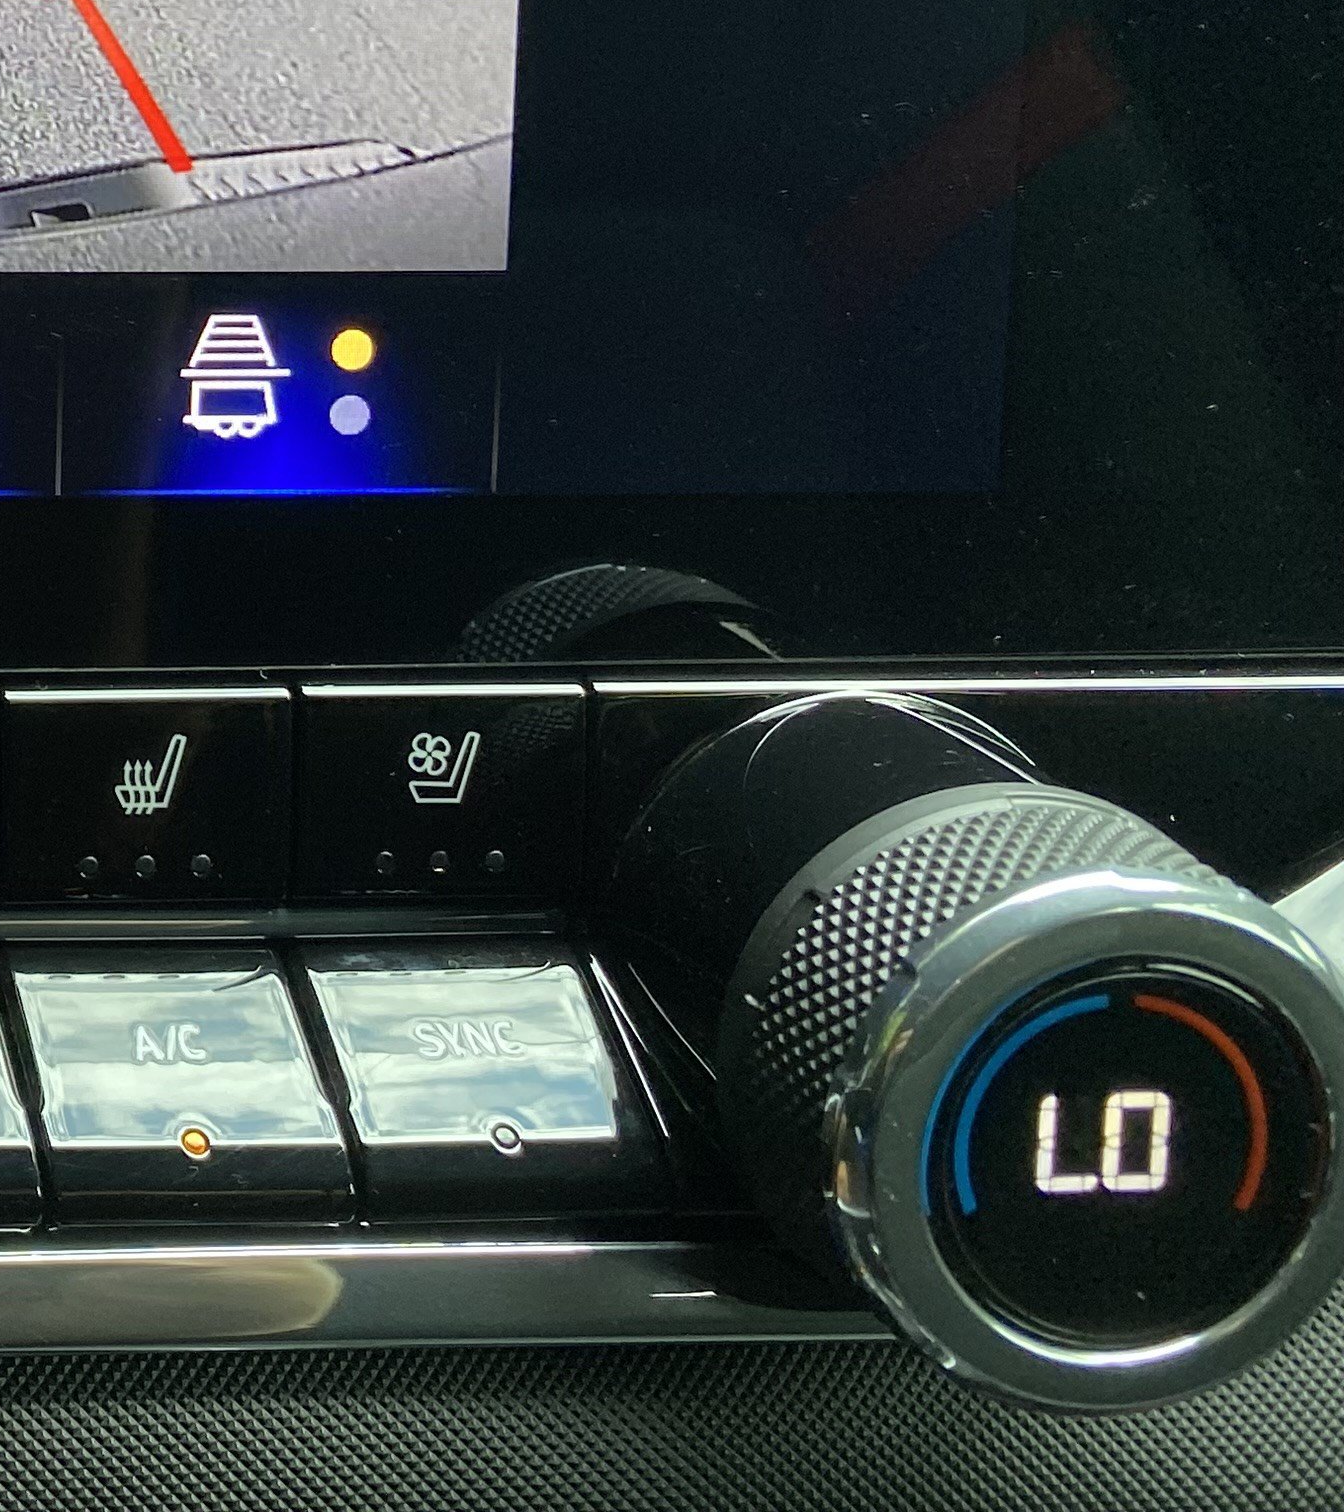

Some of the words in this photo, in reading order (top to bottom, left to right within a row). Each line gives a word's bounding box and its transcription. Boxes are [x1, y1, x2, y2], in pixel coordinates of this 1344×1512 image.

[135, 1023, 208, 1064] A/C
[414, 1018, 525, 1060] SYNC
[1034, 1090, 1171, 1192] LO
